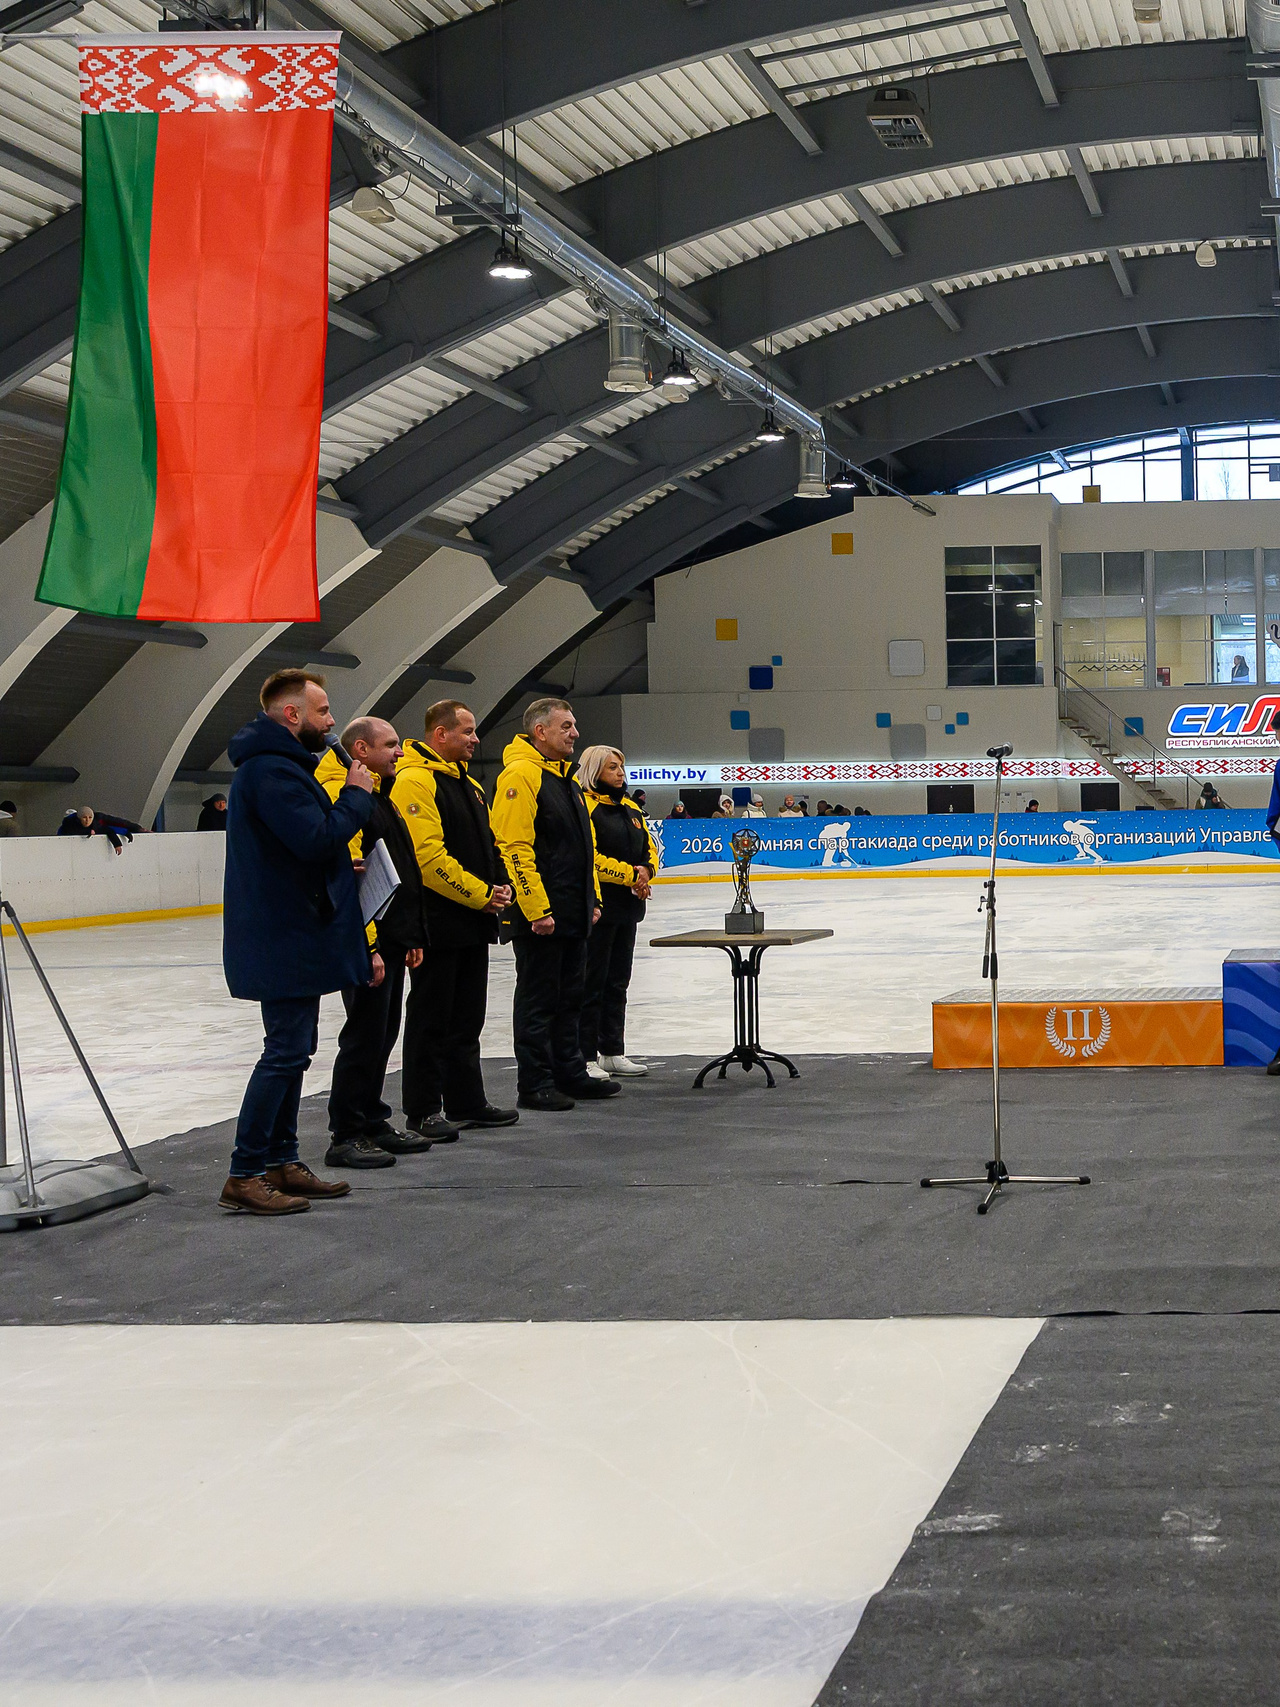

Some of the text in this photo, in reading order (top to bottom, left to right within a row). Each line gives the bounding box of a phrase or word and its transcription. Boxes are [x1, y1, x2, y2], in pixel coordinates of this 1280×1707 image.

[1167, 736, 1277, 747] РЕСПУБЛИКАНСКИЙ
[629, 767, 707, 782] silichy.by
[681, 837, 723, 854] 2026
[807, 836, 918, 854] спартакиада
[921, 834, 973, 851] среди
[977, 830, 1080, 848] работников
[1083, 828, 1197, 849] организаций
[435, 867, 473, 899] BELARUS
[511, 853, 532, 897] BELARUS
[594, 862, 626, 880] ELARUS
[1062, 1008, 1095, 1041] II
